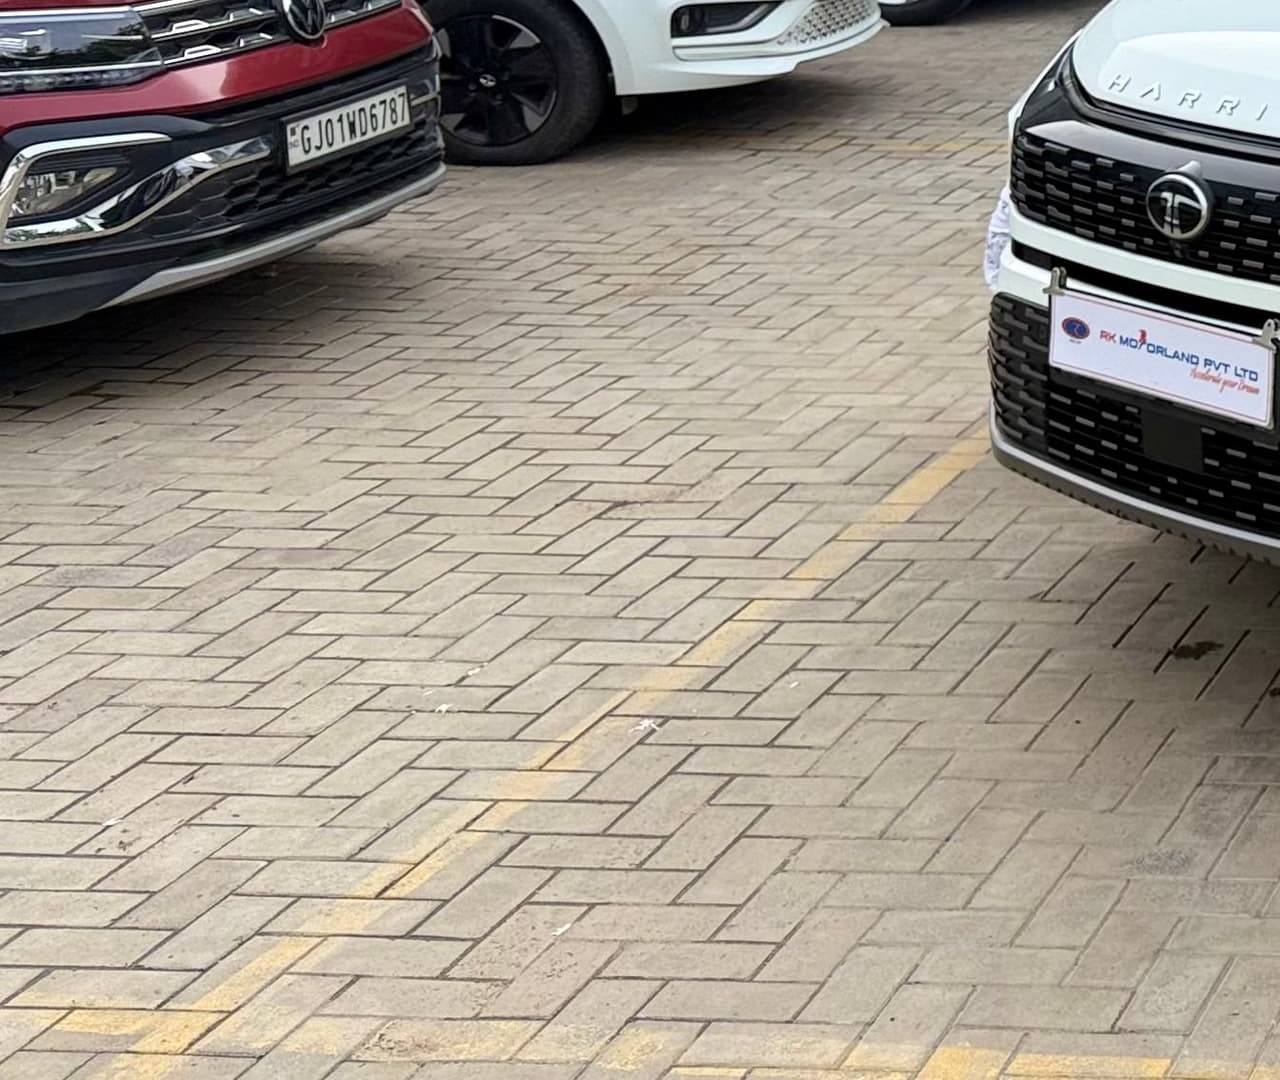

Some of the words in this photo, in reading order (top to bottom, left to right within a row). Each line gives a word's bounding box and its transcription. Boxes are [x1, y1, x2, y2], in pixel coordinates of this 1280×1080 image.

[300, 92, 406, 155] GJ01WD6787
[1099, 329, 1117, 344] RK
[1203, 357, 1232, 374] PVT
[1234, 365, 1259, 382] LTD
